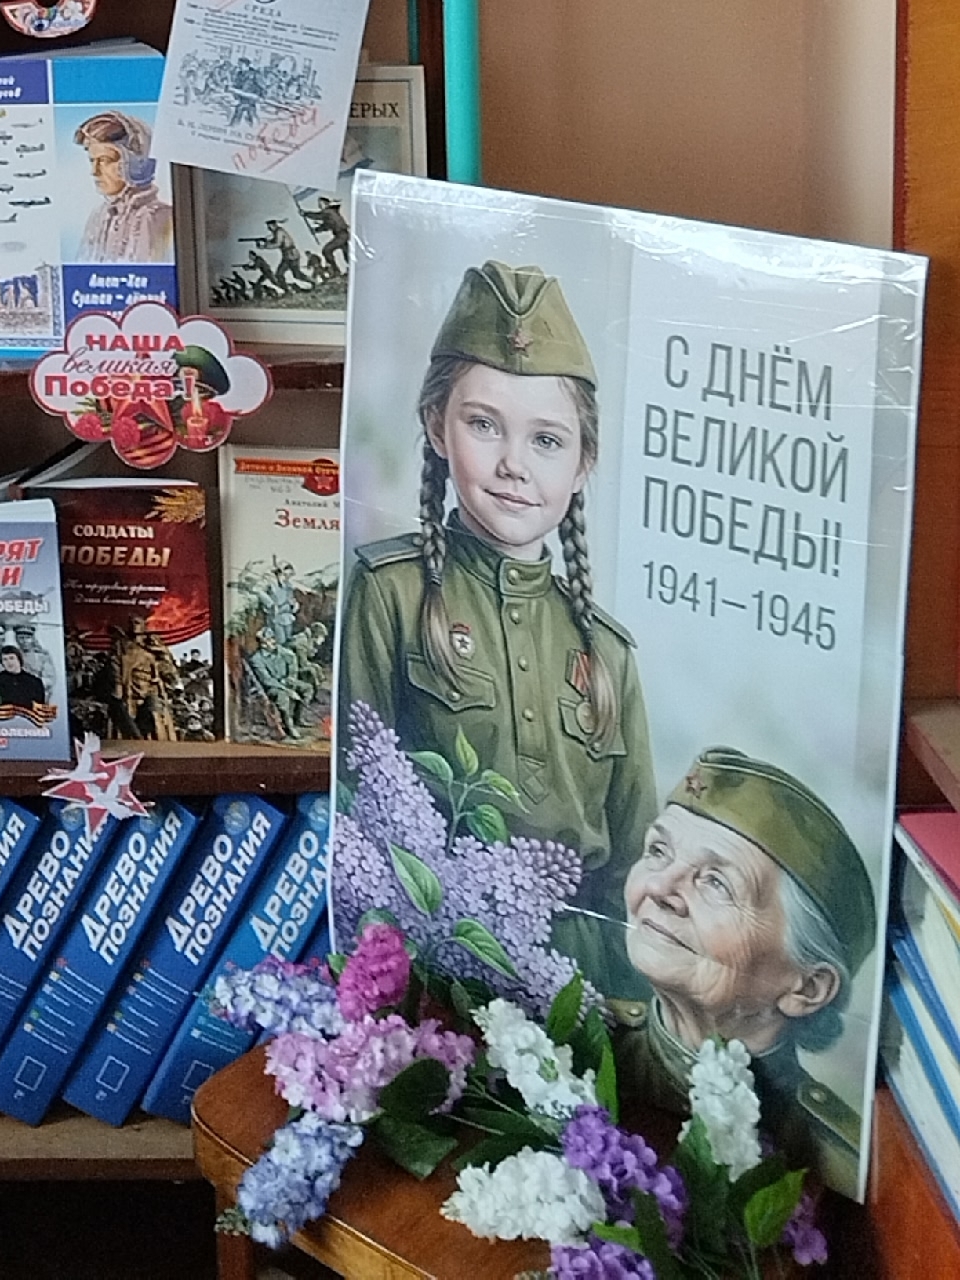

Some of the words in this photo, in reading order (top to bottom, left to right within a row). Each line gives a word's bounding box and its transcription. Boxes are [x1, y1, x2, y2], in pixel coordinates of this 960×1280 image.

[63, 347, 177, 375] великая
[85, 334, 185, 351] НАША
[664, 334, 691, 389] С
[702, 341, 833, 422] ДНЁМ
[644, 403, 849, 504] ВЕЛИКОЙ
[61, 545, 171, 567] ПОБЕДЫ
[73, 524, 154, 539] СОЛДАТЫ
[274, 508, 340, 531] Земля
[642, 476, 841, 578] ПОБЕДЫ!
[3, 830, 70, 949] ДРЕВО
[81, 832, 148, 951] ДРЕВО
[98, 811, 182, 965] ПОЗНАНИЯ
[165, 834, 233, 951] ДРЕВО
[184, 811, 272, 965] ПОЗНАНИЯ
[249, 830, 319, 953] ДРЕВО
